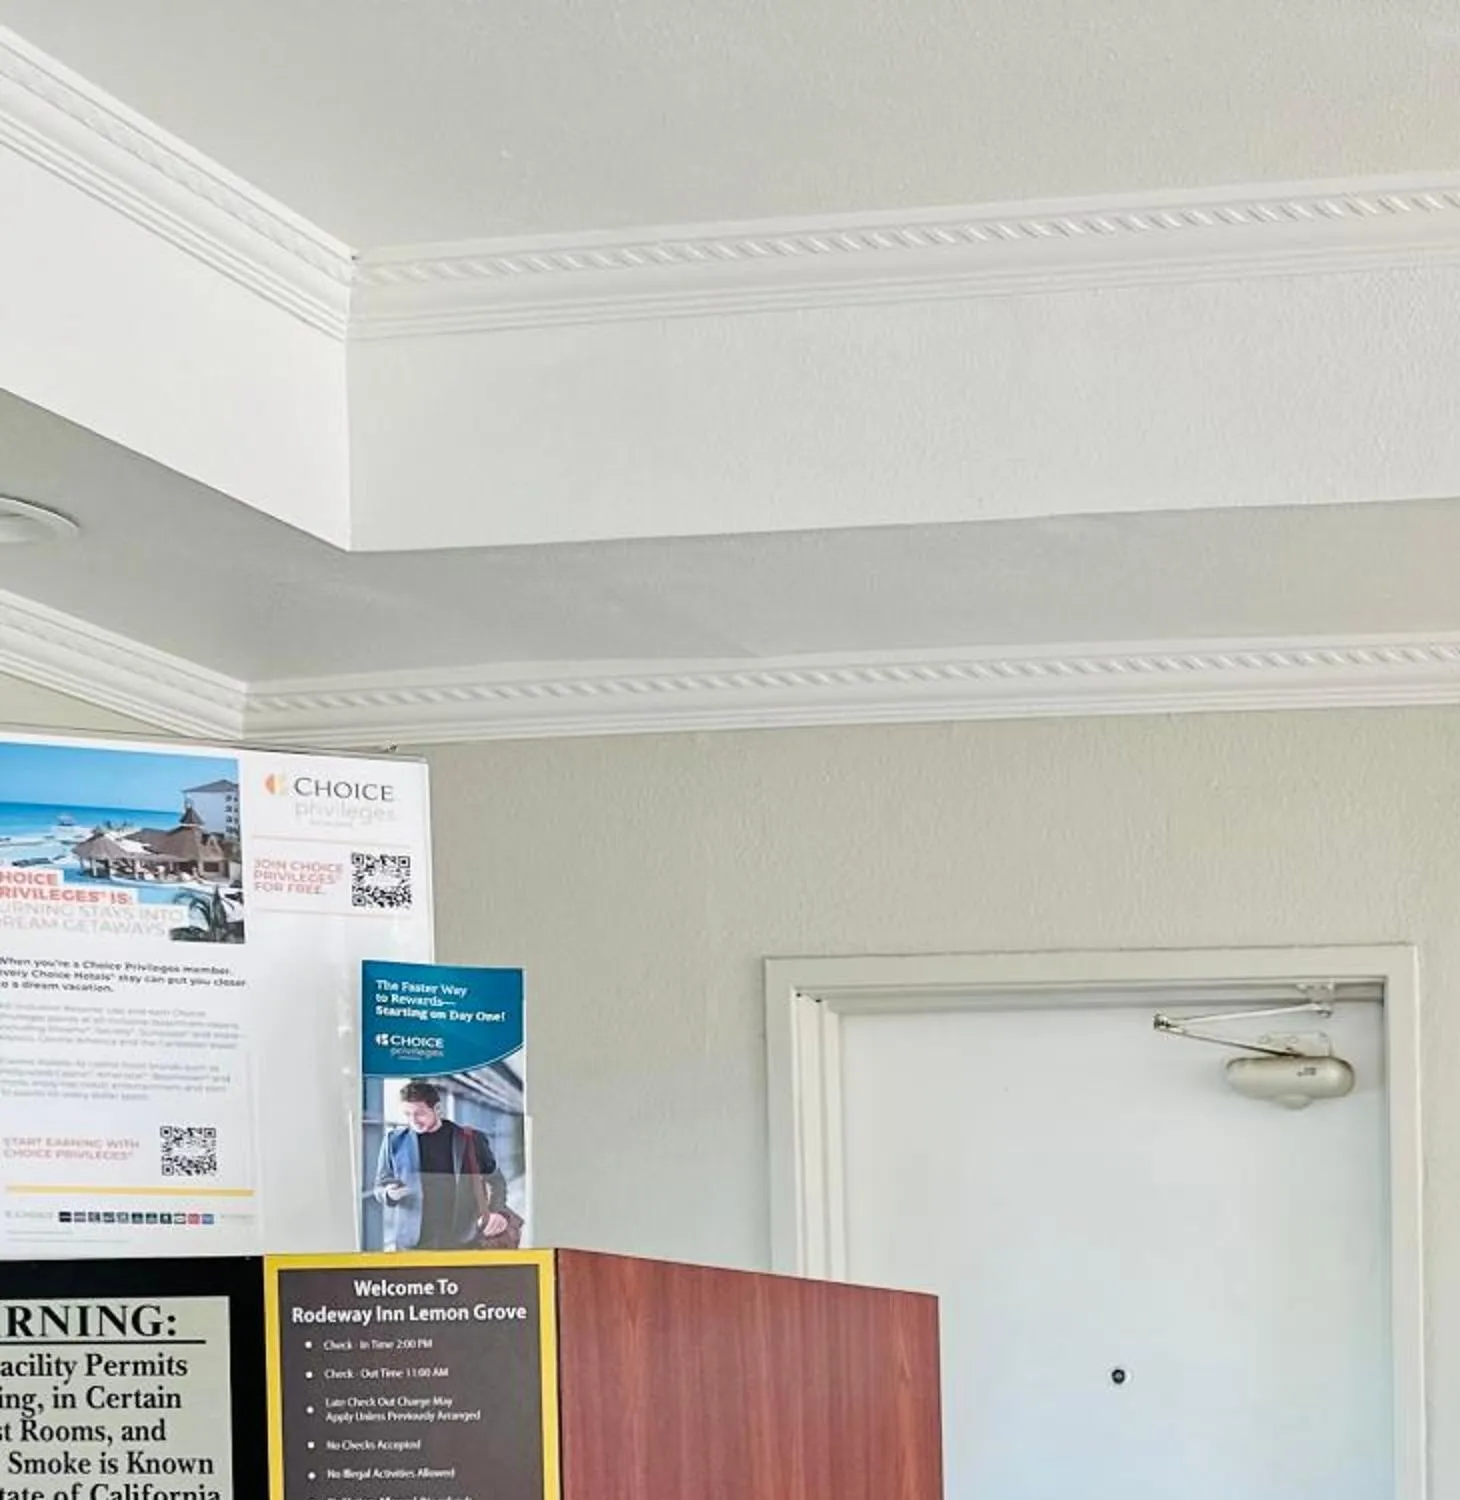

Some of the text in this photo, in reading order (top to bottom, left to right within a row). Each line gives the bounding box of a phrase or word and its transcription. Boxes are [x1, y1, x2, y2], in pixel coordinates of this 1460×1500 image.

[293, 777, 395, 802] CHOICE
[375, 979, 468, 998] The Faster Way
[375, 993, 389, 1002] to
[375, 1005, 506, 1023] Starting on Day One!
[389, 1034, 445, 1049] CHOICE
[353, 1278, 459, 1297] Welcome To
[5, 1304, 177, 1338] RNING:
[292, 1303, 528, 1327] Rodeway Inn Lemon Grove
[417, 1338, 433, 1348] PM
[0, 1352, 189, 1385] acility Permits
[360, 1367, 379, 1379] Out
[380, 1367, 405, 1378] Time
[432, 1367, 449, 1377] AM
[52, 1384, 182, 1409] in Certain
[20, 1417, 167, 1447] Rooms, and
[7, 1450, 215, 1475] Smoke is Known
